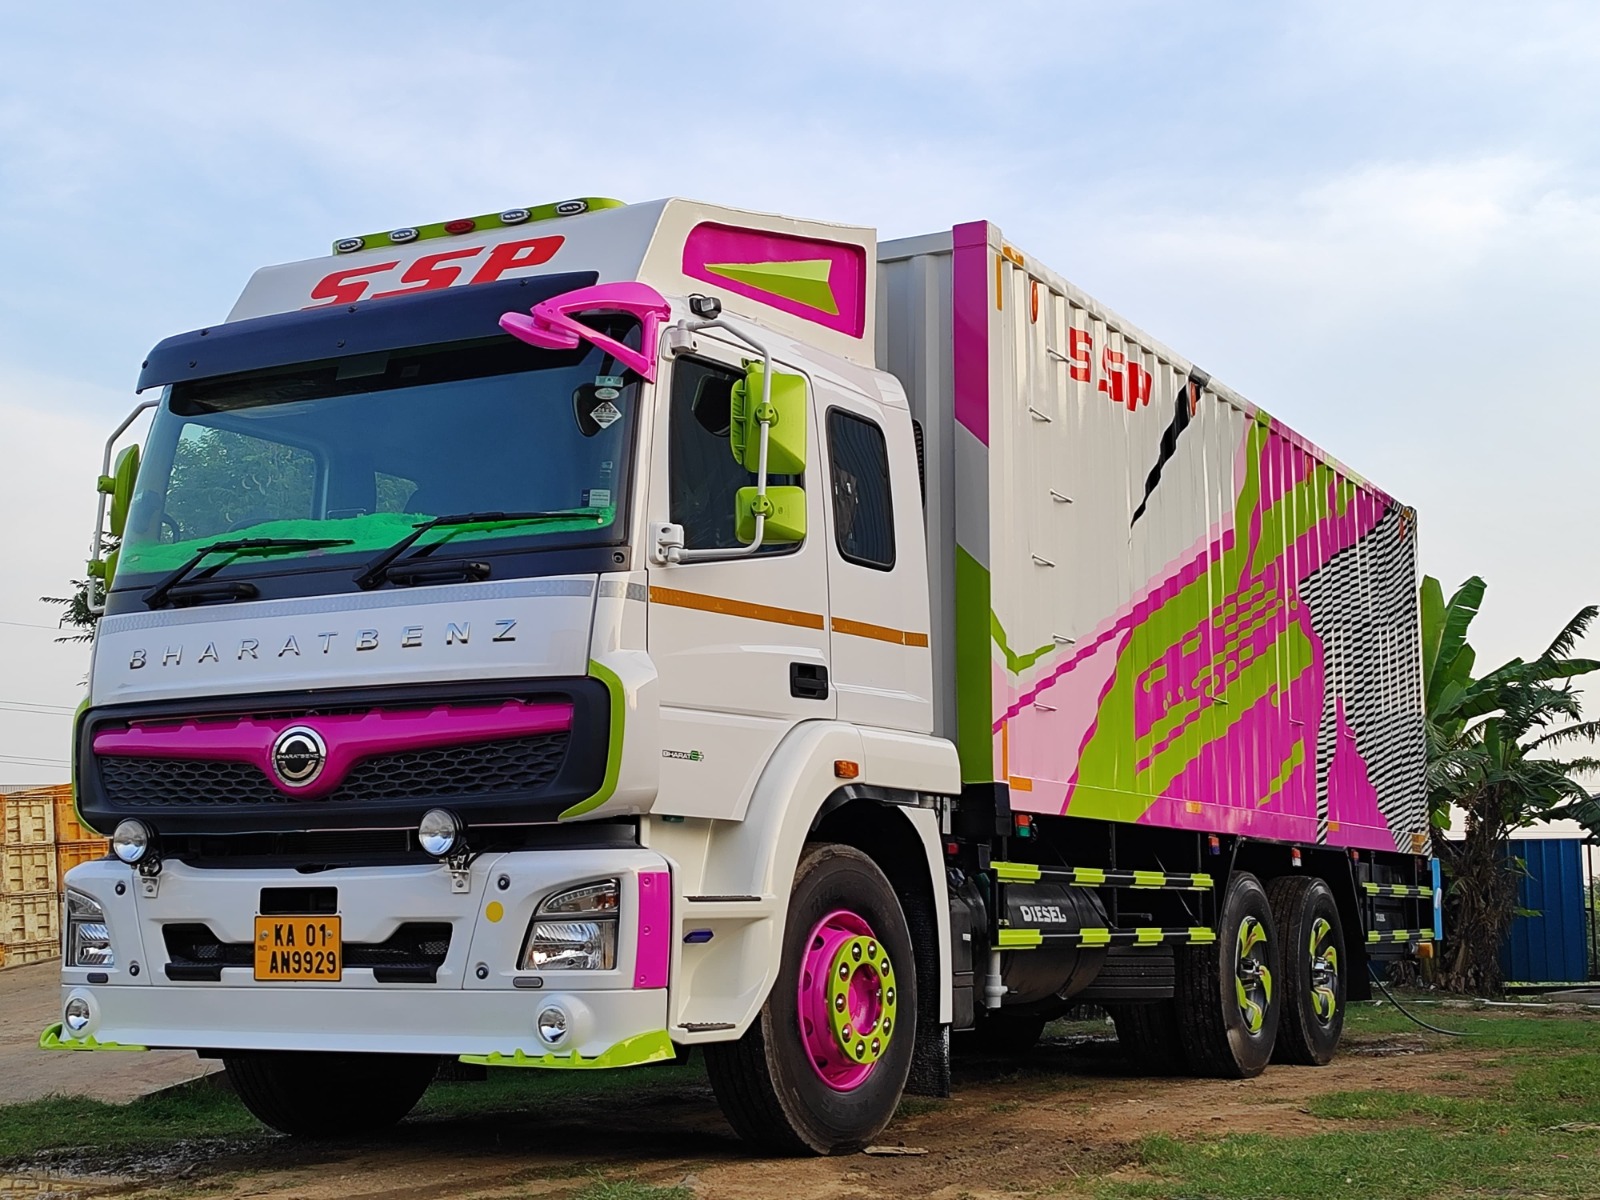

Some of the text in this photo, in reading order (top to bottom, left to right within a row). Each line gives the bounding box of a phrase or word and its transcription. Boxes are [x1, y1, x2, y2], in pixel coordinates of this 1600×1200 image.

[301, 235, 566, 310] SSP
[1069, 326, 1152, 412] SSP
[129, 619, 518, 670] BHARATBENZ
[1020, 905, 1067, 923] DIESEL
[274, 923, 326, 947] KA 01
[269, 950, 337, 974] AN9929
